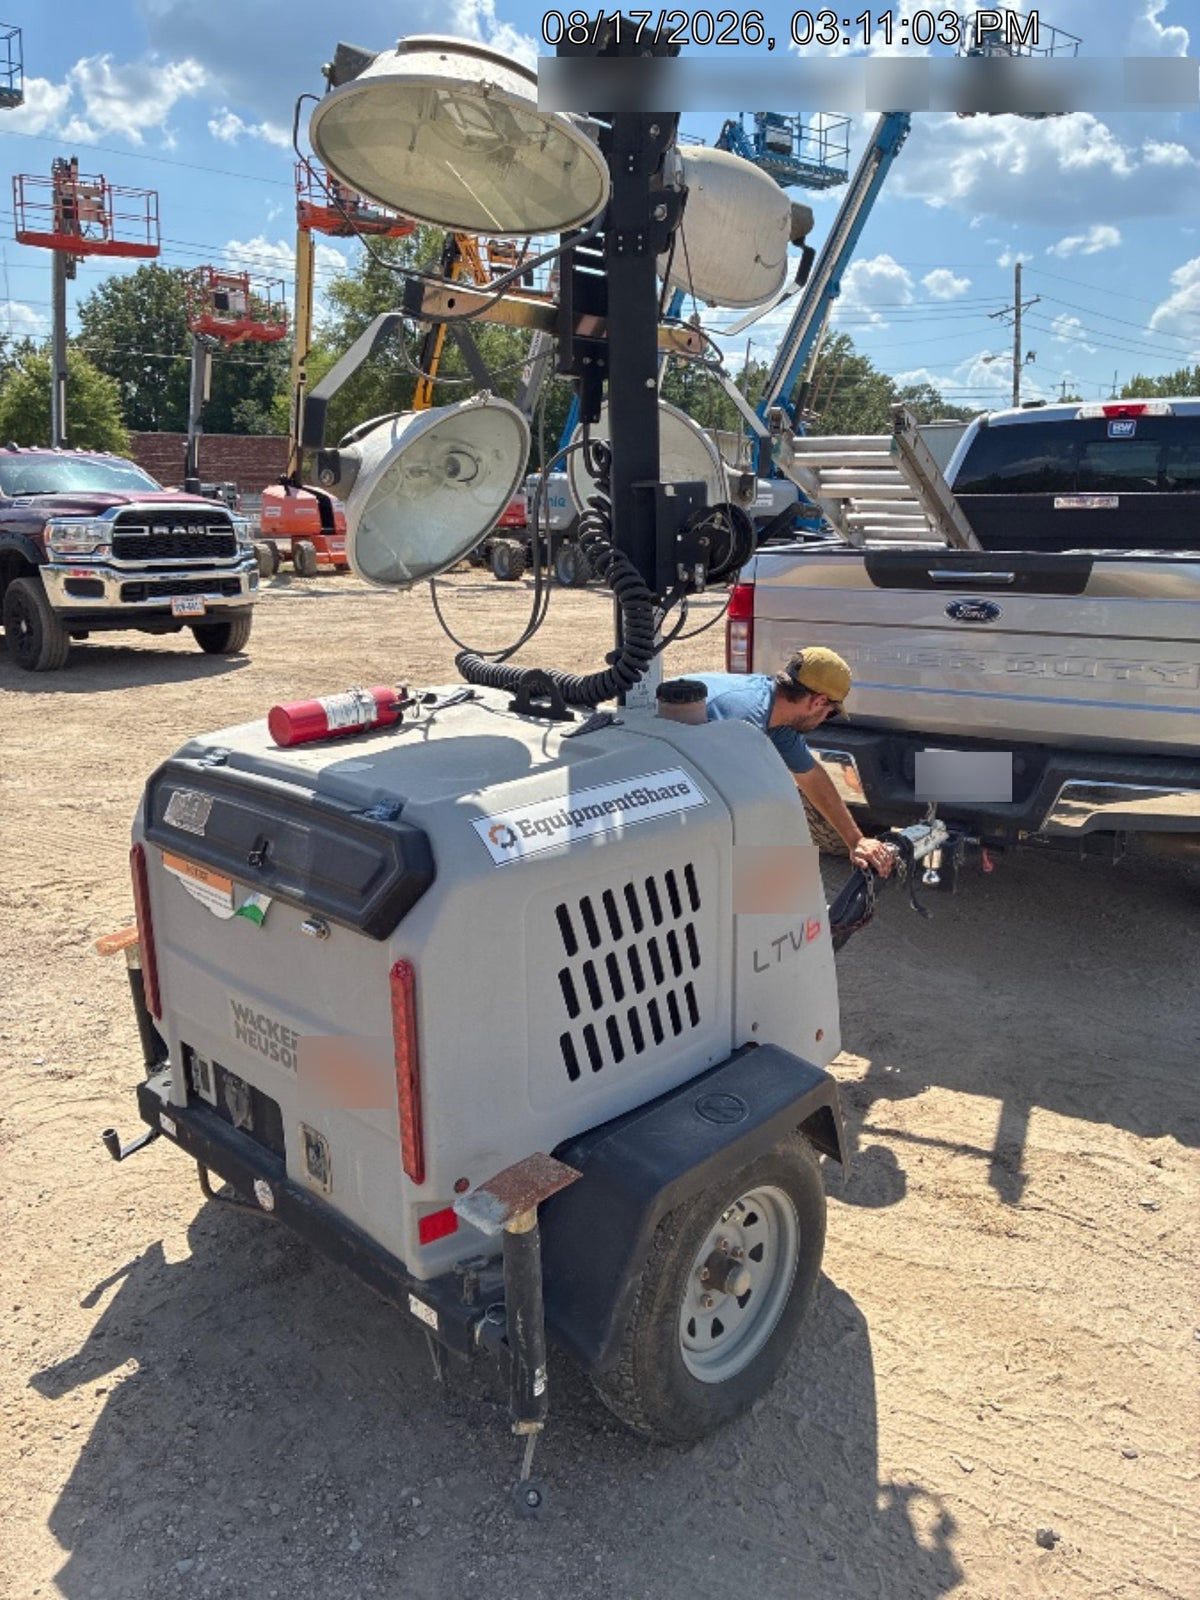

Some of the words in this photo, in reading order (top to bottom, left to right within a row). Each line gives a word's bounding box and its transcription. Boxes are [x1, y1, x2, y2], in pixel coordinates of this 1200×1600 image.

[152, 526, 205, 535] RAM
[1005, 651, 1193, 684] DUTY
[515, 781, 691, 839] EquipmentShare
[753, 917, 822, 973] LTV6
